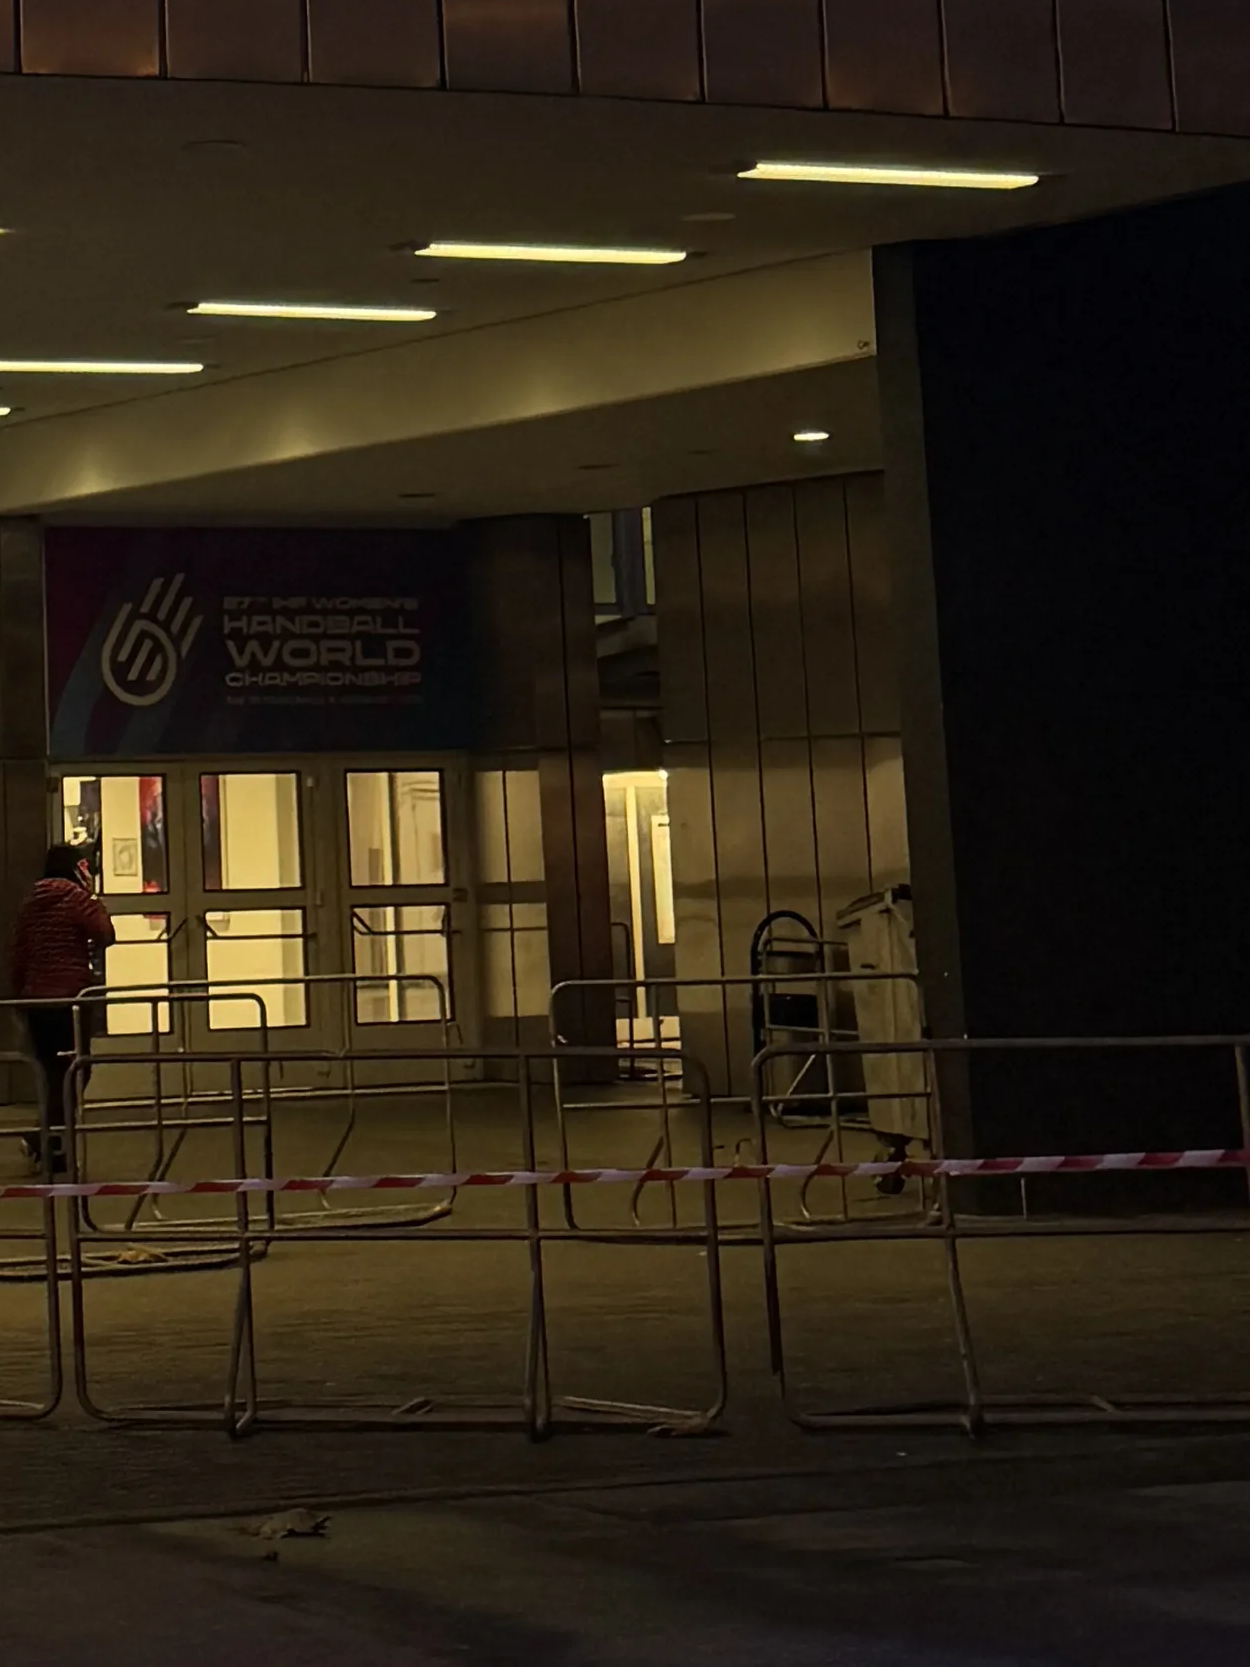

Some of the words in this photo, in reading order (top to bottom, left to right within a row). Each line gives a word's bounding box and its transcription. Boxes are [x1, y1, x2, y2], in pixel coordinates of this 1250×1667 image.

[223, 613, 421, 635] HANDBALL
[224, 638, 422, 668] WORLD
[224, 670, 423, 688] CHAMPIONSHIP
